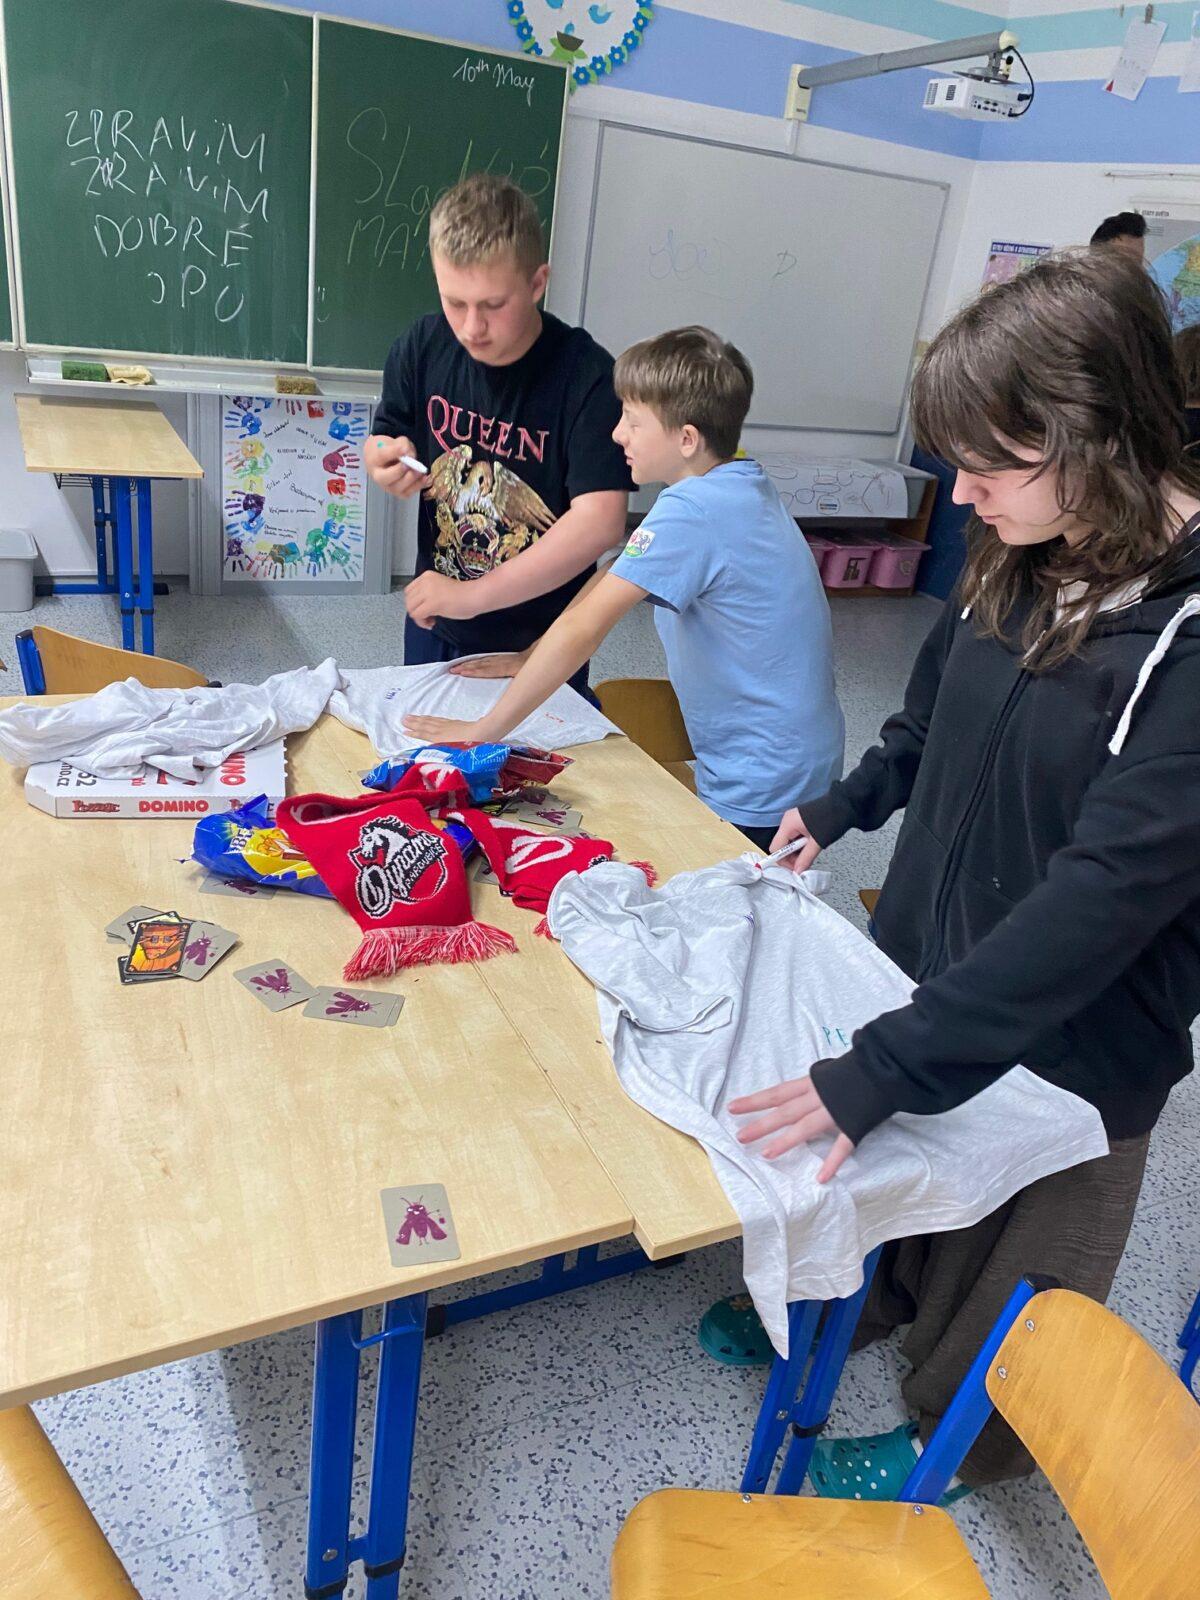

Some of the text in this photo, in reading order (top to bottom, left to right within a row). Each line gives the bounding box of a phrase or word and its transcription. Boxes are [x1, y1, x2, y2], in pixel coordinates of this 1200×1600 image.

[452, 57, 535, 107] 10th May
[427, 394, 550, 463] QUEEN
[138, 800, 209, 813] DOMINO
